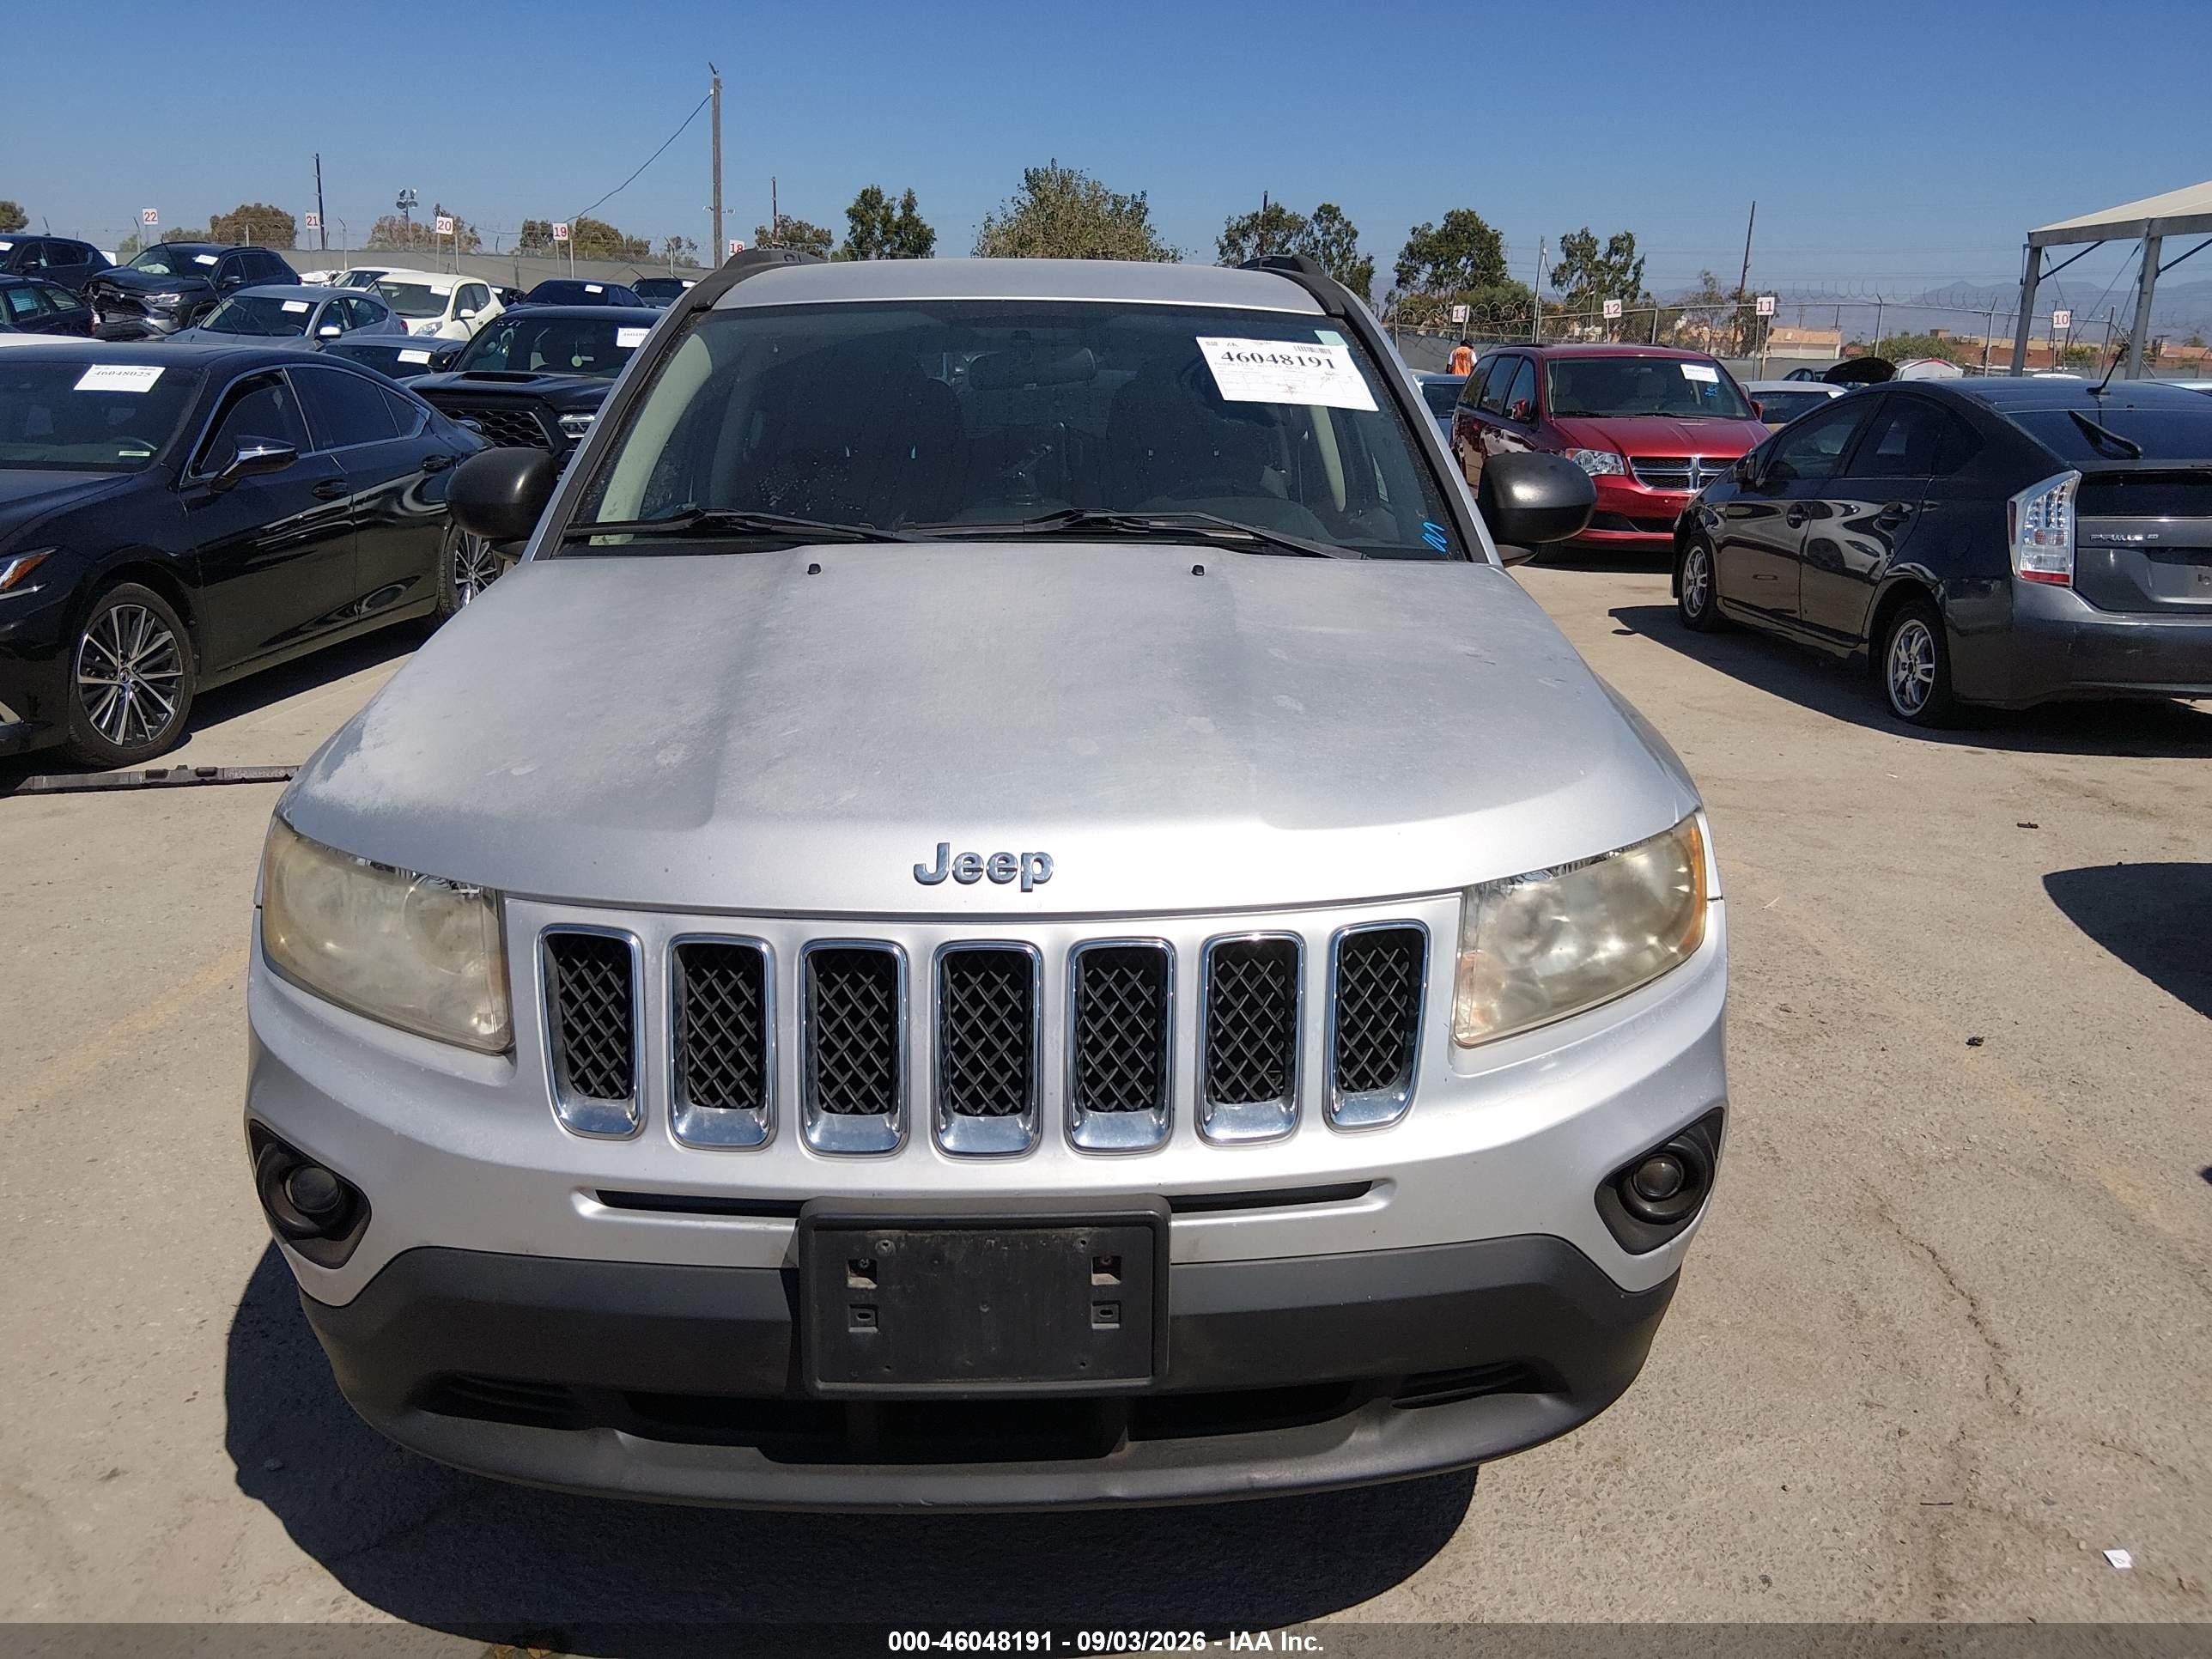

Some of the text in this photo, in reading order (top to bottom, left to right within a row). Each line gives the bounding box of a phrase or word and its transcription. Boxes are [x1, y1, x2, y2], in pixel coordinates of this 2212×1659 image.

[144, 211, 158, 222] 22
[306, 216, 319, 227] 21
[438, 220, 452, 231] 20
[554, 227, 567, 237] 19
[729, 243, 744, 254] 18
[1604, 303, 1620, 315] 12
[1757, 301, 1773, 312] 11
[2054, 314, 2069, 325] 10
[1221, 351, 1336, 369] 46048191
[913, 842, 1054, 893] Jeep
